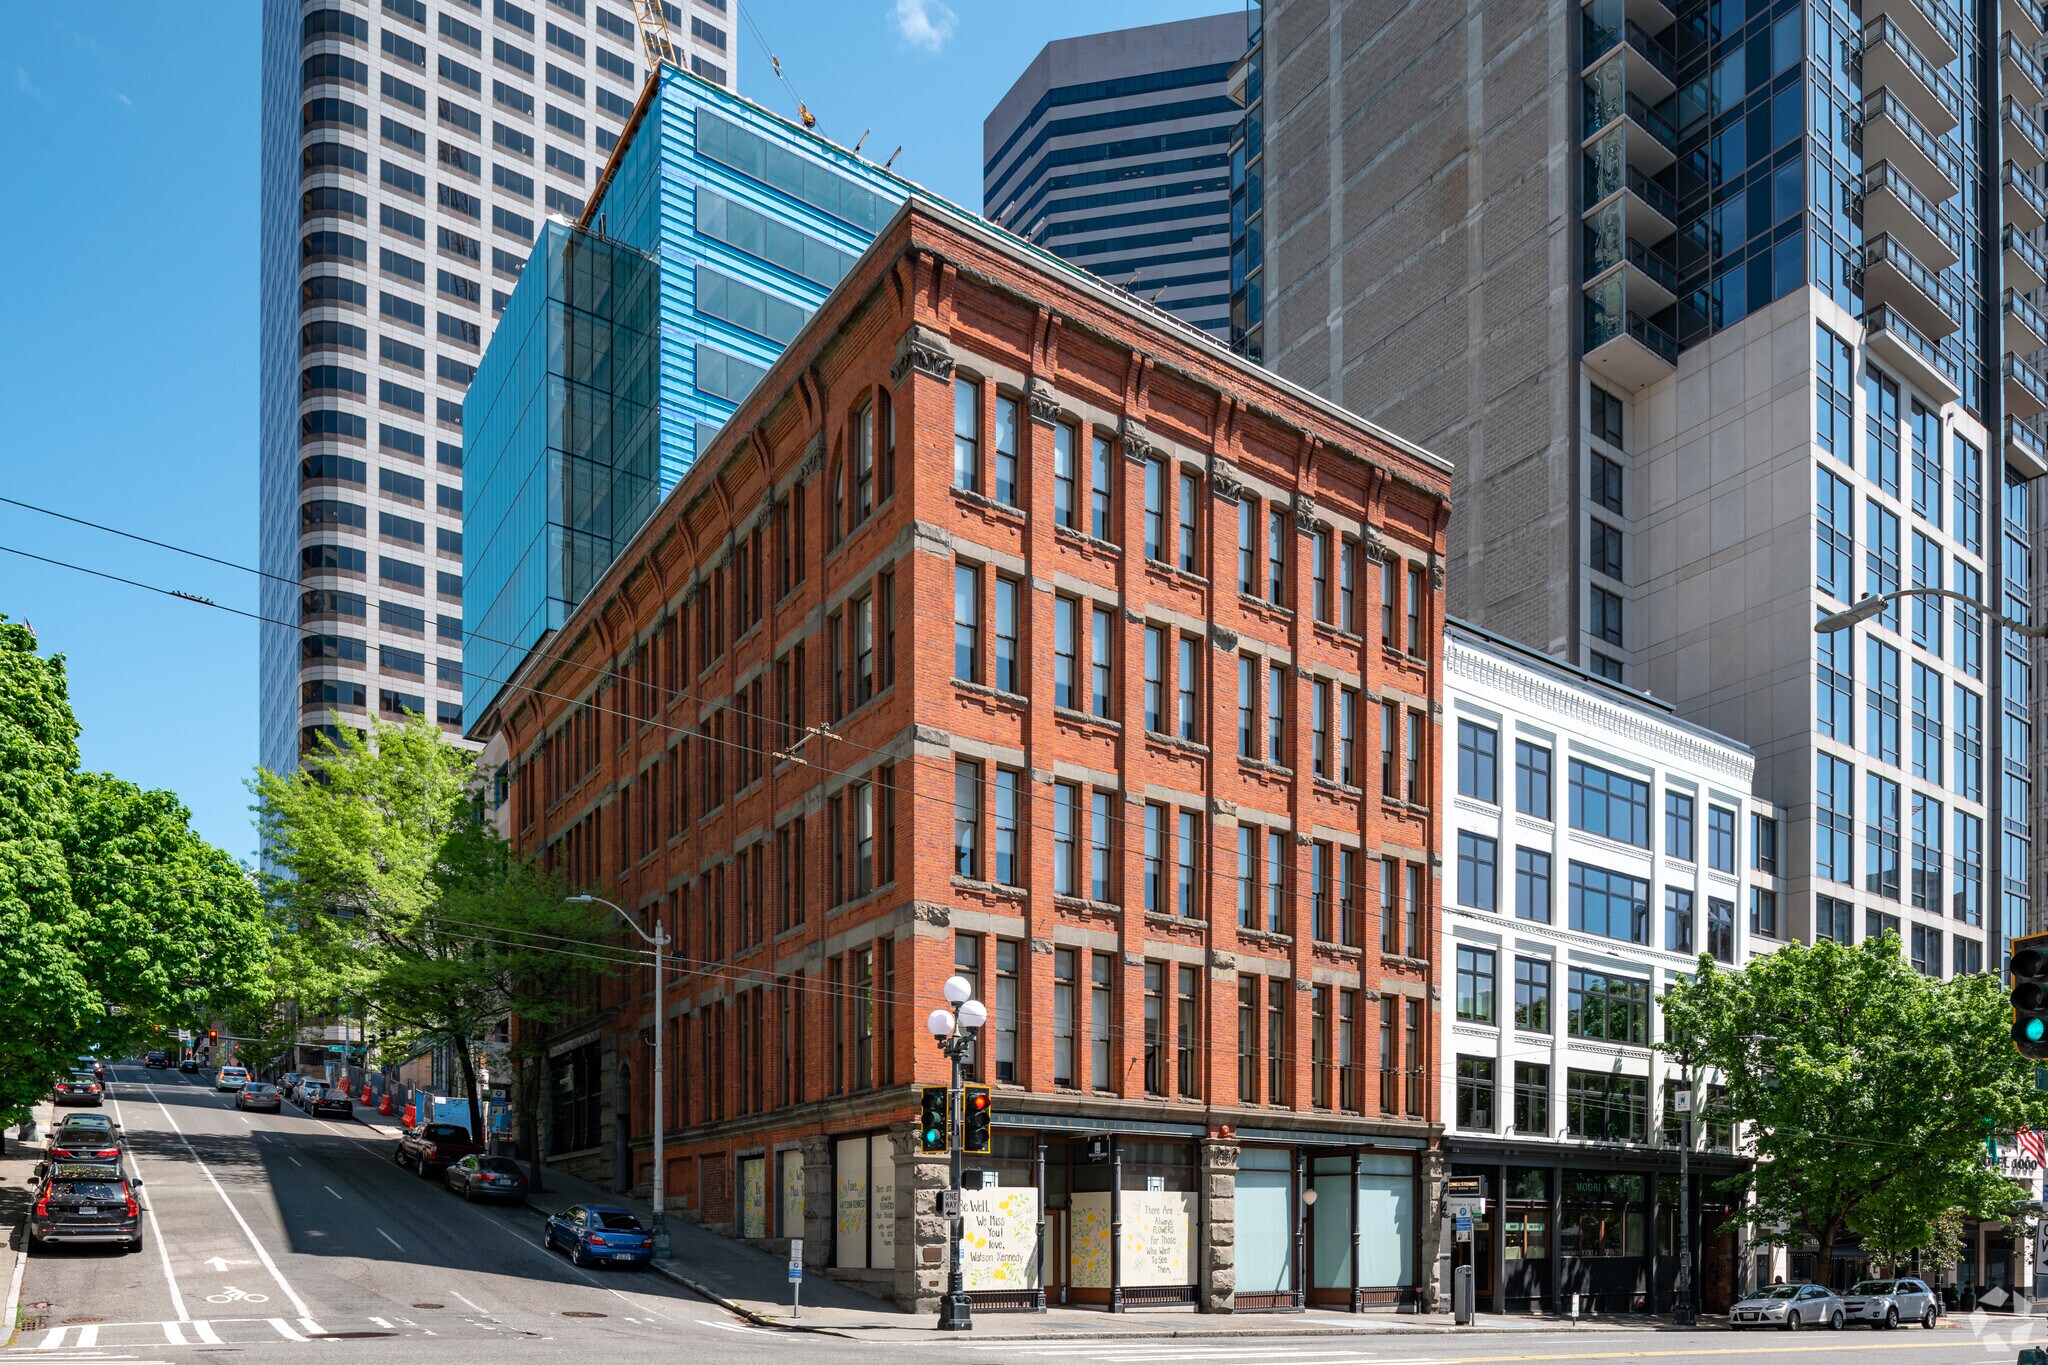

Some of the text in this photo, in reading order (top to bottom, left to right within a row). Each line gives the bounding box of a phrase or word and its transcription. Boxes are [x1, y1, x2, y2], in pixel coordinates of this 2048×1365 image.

[997, 1115, 1073, 1126] HOLYOKE
[2011, 1157, 2038, 1170] 1000
[960, 1200, 990, 1212] Be Well.
[1145, 1205, 1173, 1214] There Are
[976, 1215, 1006, 1226] We Miss
[1154, 1217, 1173, 1226] Always
[987, 1227, 1004, 1238] You!
[1152, 1226, 1174, 1234] FLOWERS
[1161, 1236, 1176, 1245] Those
[1146, 1247, 1171, 1256] Who Want
[970, 1251, 1024, 1265] Watson Kennedy
